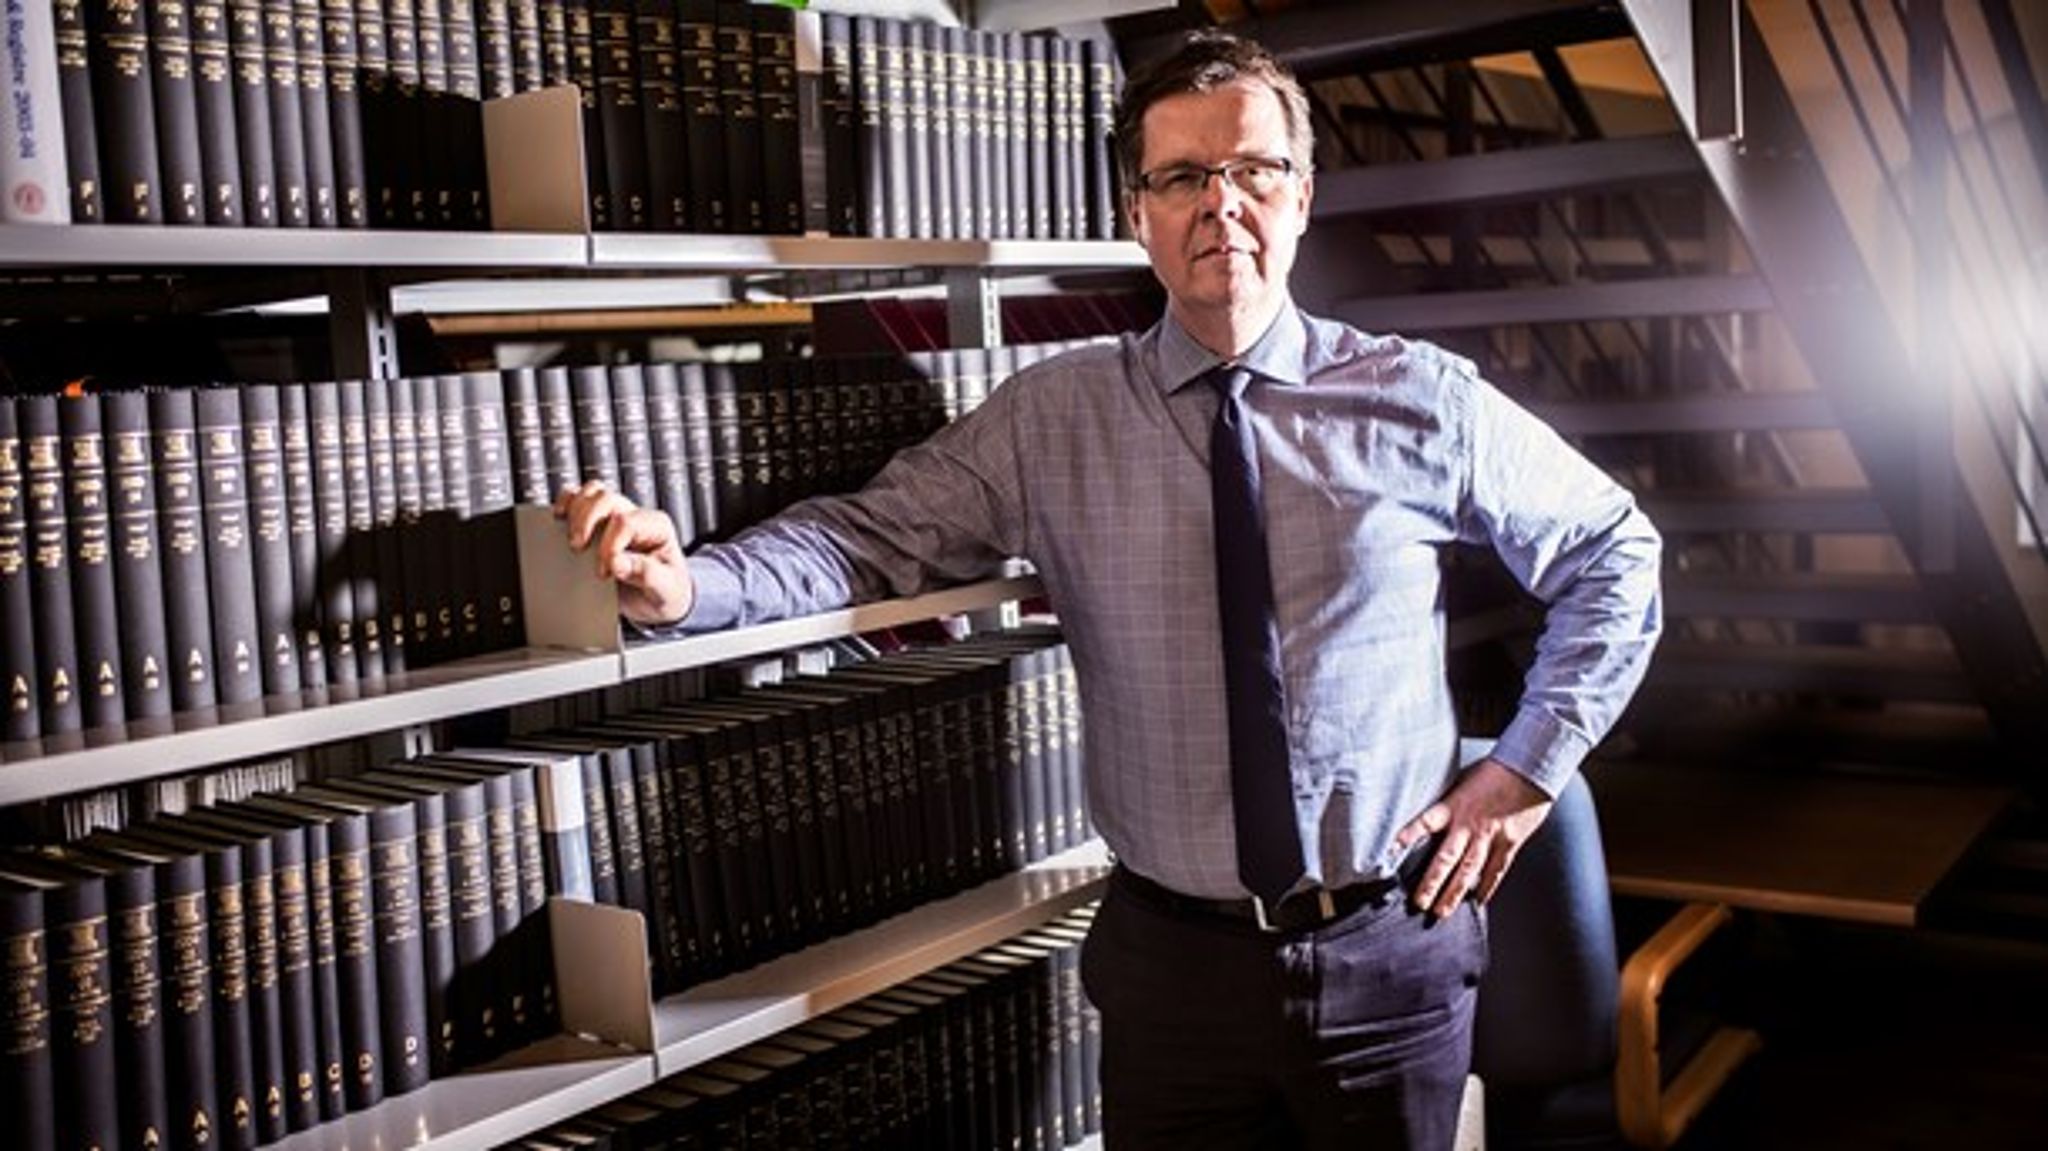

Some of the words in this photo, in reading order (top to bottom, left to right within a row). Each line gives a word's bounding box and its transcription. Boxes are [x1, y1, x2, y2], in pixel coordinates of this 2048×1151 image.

[235, 641, 249, 658] A
[277, 633, 290, 650] A
[143, 655, 158, 675] A
[188, 648, 202, 666] A
[53, 667, 69, 686] A
[100, 661, 114, 679] A
[12, 674, 28, 693] A
[268, 1086, 280, 1101] A
[234, 1096, 249, 1114] A
[194, 1110, 209, 1130] A
[143, 1126, 159, 1147] A
